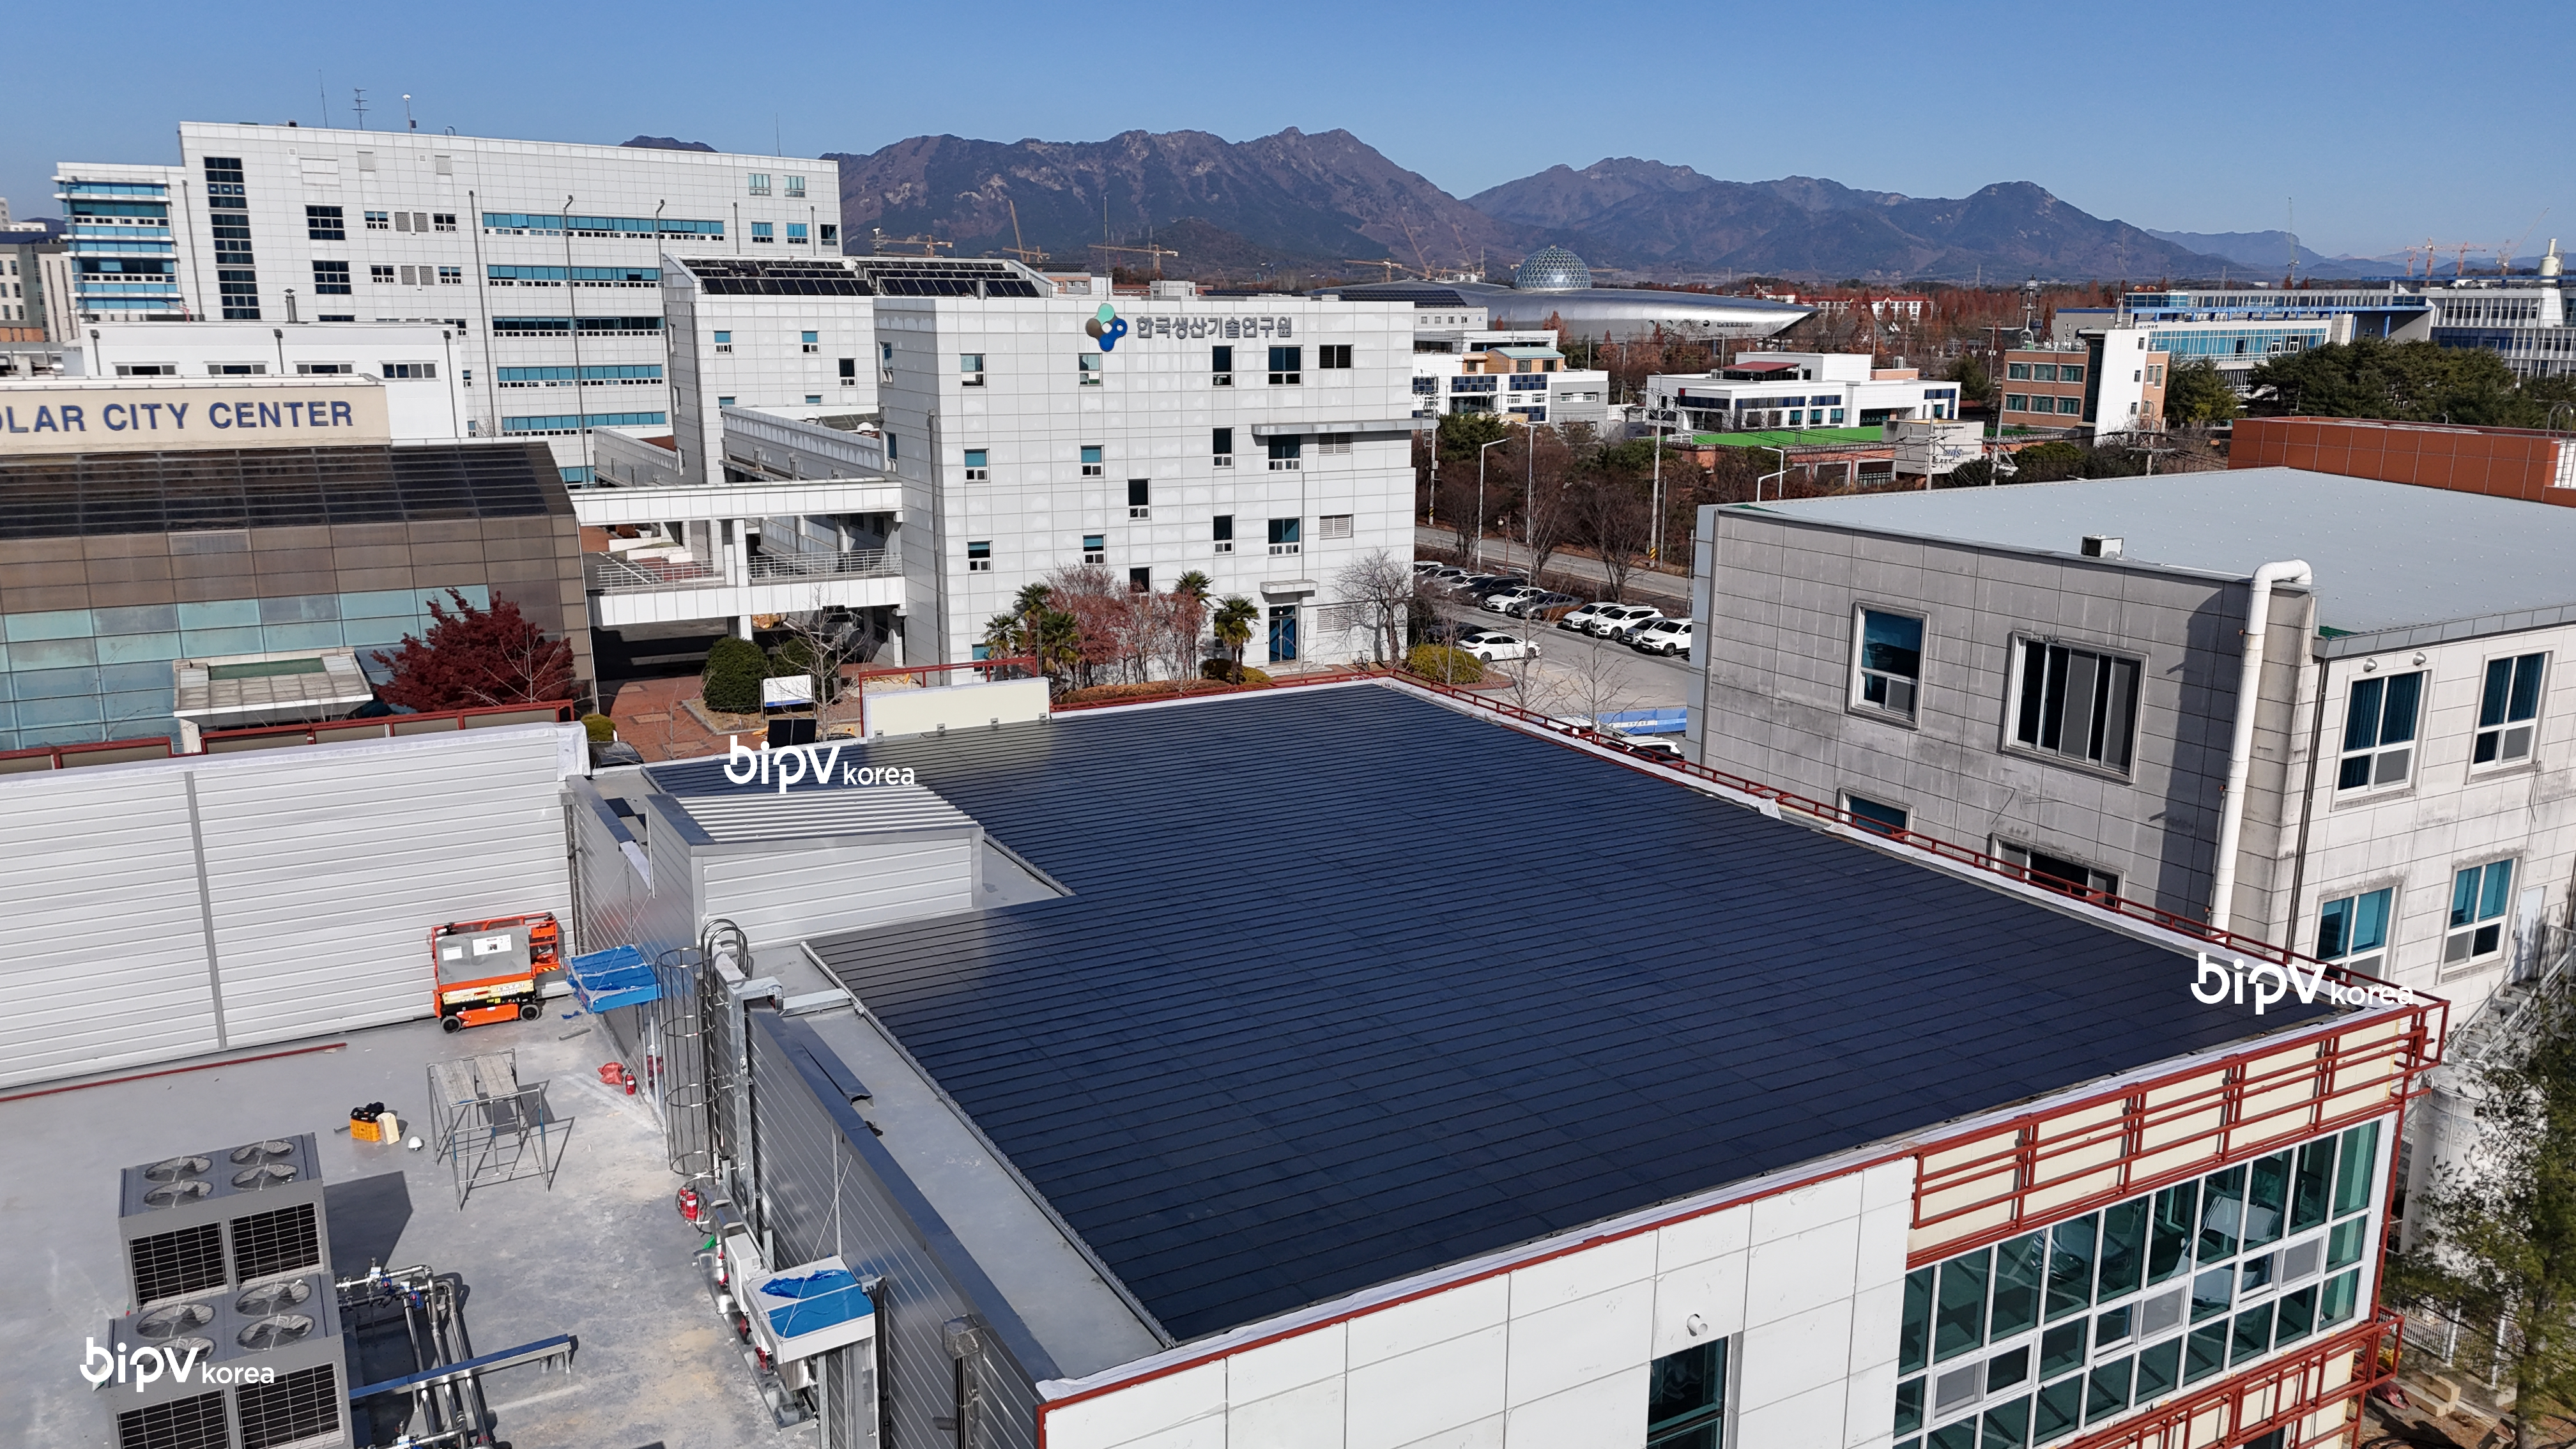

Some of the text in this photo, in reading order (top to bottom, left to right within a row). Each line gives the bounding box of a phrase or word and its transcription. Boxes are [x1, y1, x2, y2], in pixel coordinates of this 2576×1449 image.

[1135, 316, 1292, 339] 한국생산기술연구원
[0, 401, 353, 433] LAR CITY CENTER
